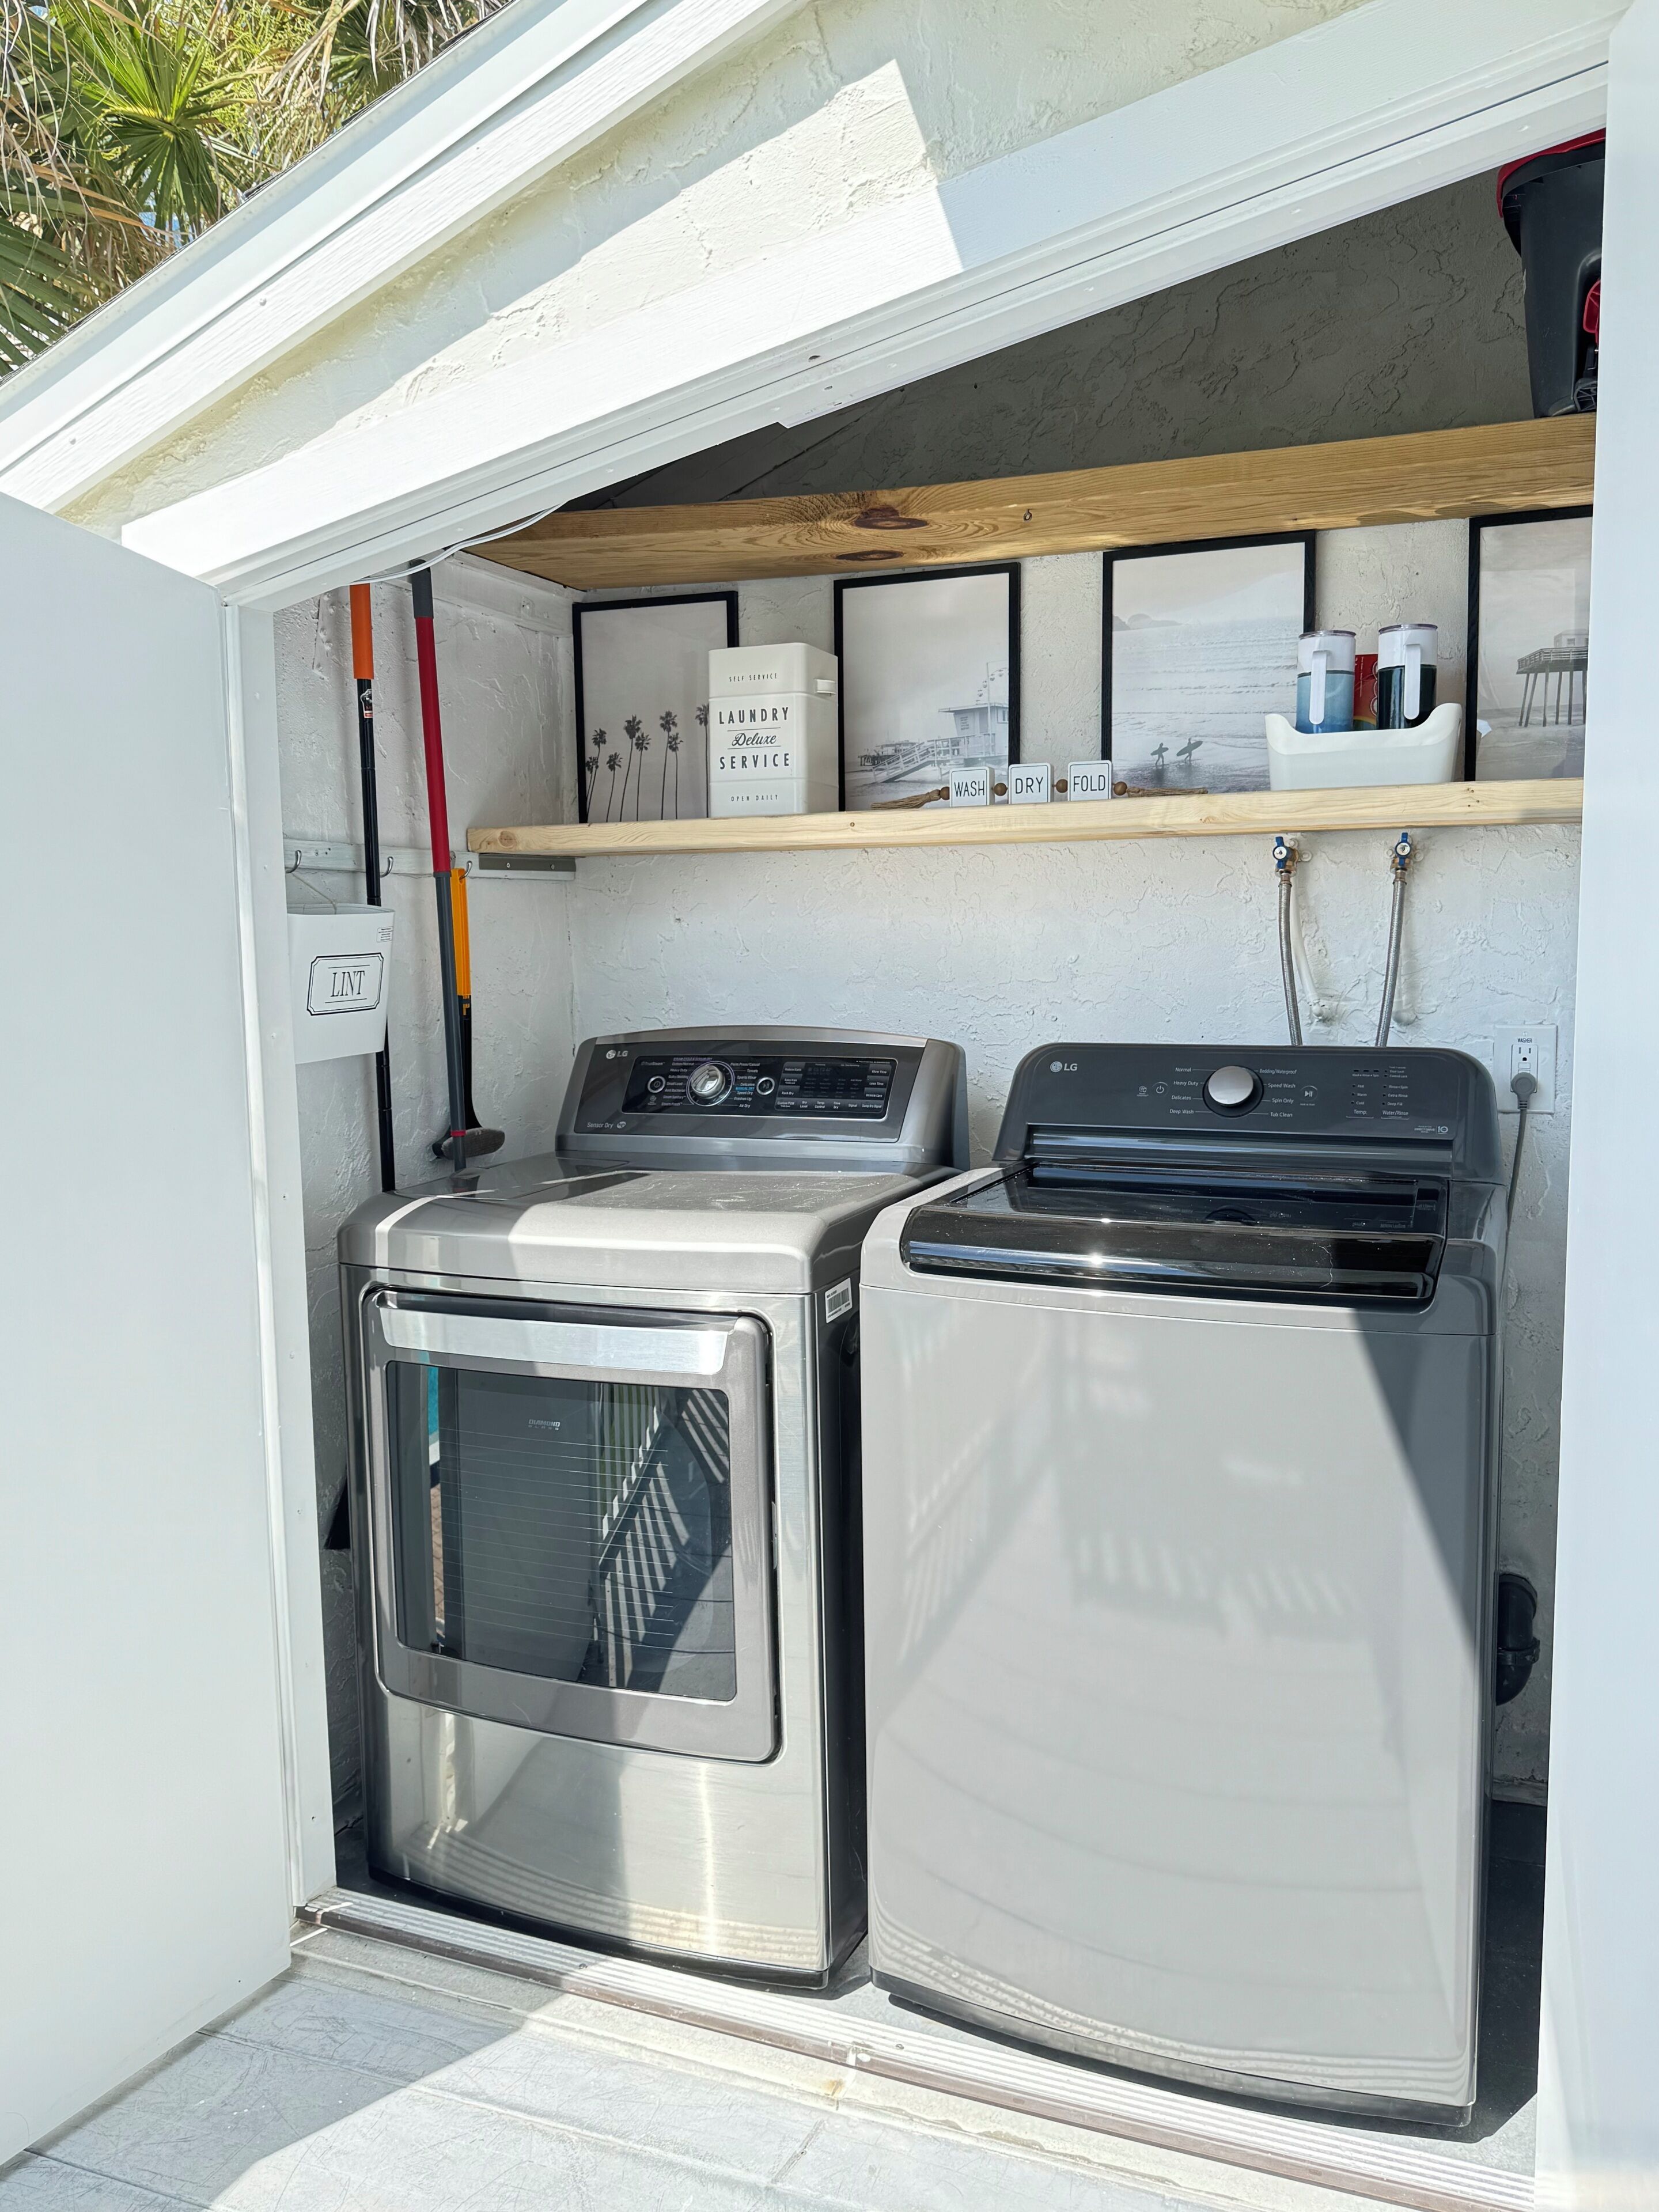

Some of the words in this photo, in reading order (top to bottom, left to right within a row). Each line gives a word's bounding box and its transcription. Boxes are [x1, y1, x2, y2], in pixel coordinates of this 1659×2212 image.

[719, 706, 789, 725] LAUNDRY
[731, 732, 777, 747] Deluxe
[719, 753, 790, 770] SERVICE
[953, 781, 985, 797] WASH
[1015, 777, 1044, 794] DRY
[1073, 775, 1106, 792] FOLD
[330, 970, 365, 997] LINT
[528, 1419, 560, 1427] DIAMOND
